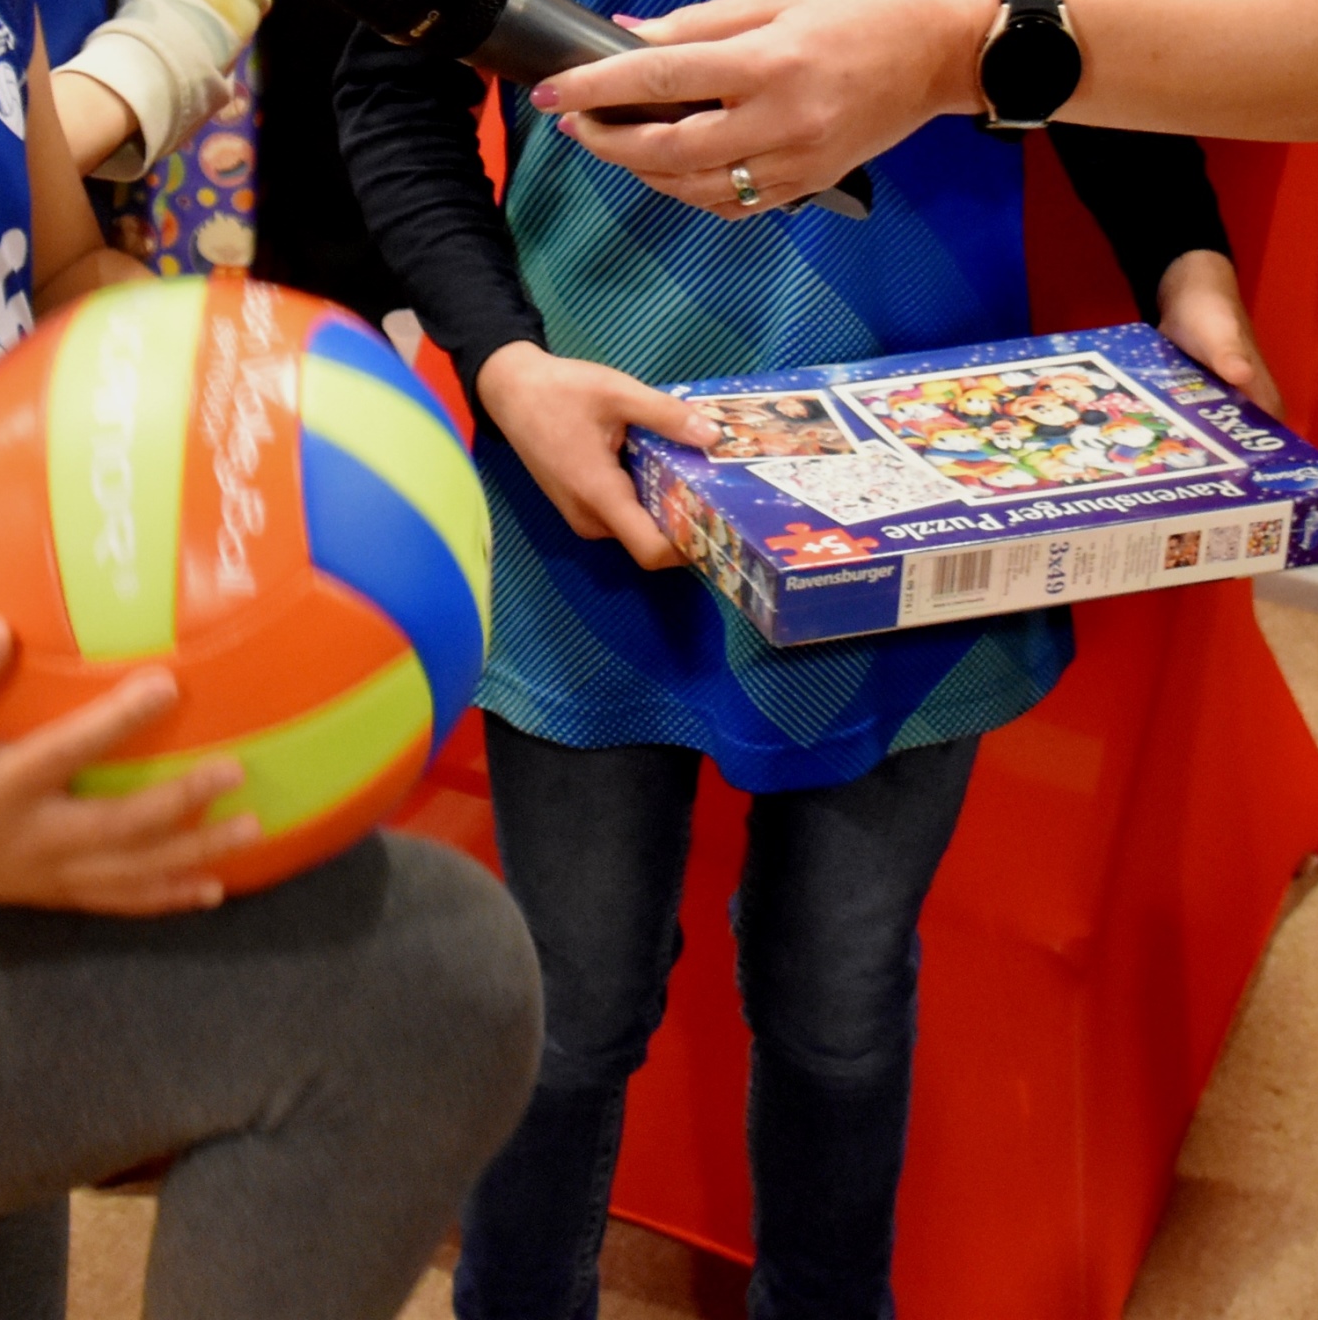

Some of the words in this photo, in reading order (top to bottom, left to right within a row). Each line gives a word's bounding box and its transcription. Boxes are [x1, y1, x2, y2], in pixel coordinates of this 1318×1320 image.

[1197, 403, 1286, 452] 3x49
[1007, 479, 1247, 526] Ravensburger
[802, 534, 853, 556] 5+
[881, 511, 1006, 542] Puzzle
[785, 565, 895, 592] Ravensburger
[1045, 541, 1071, 596] 3x49
